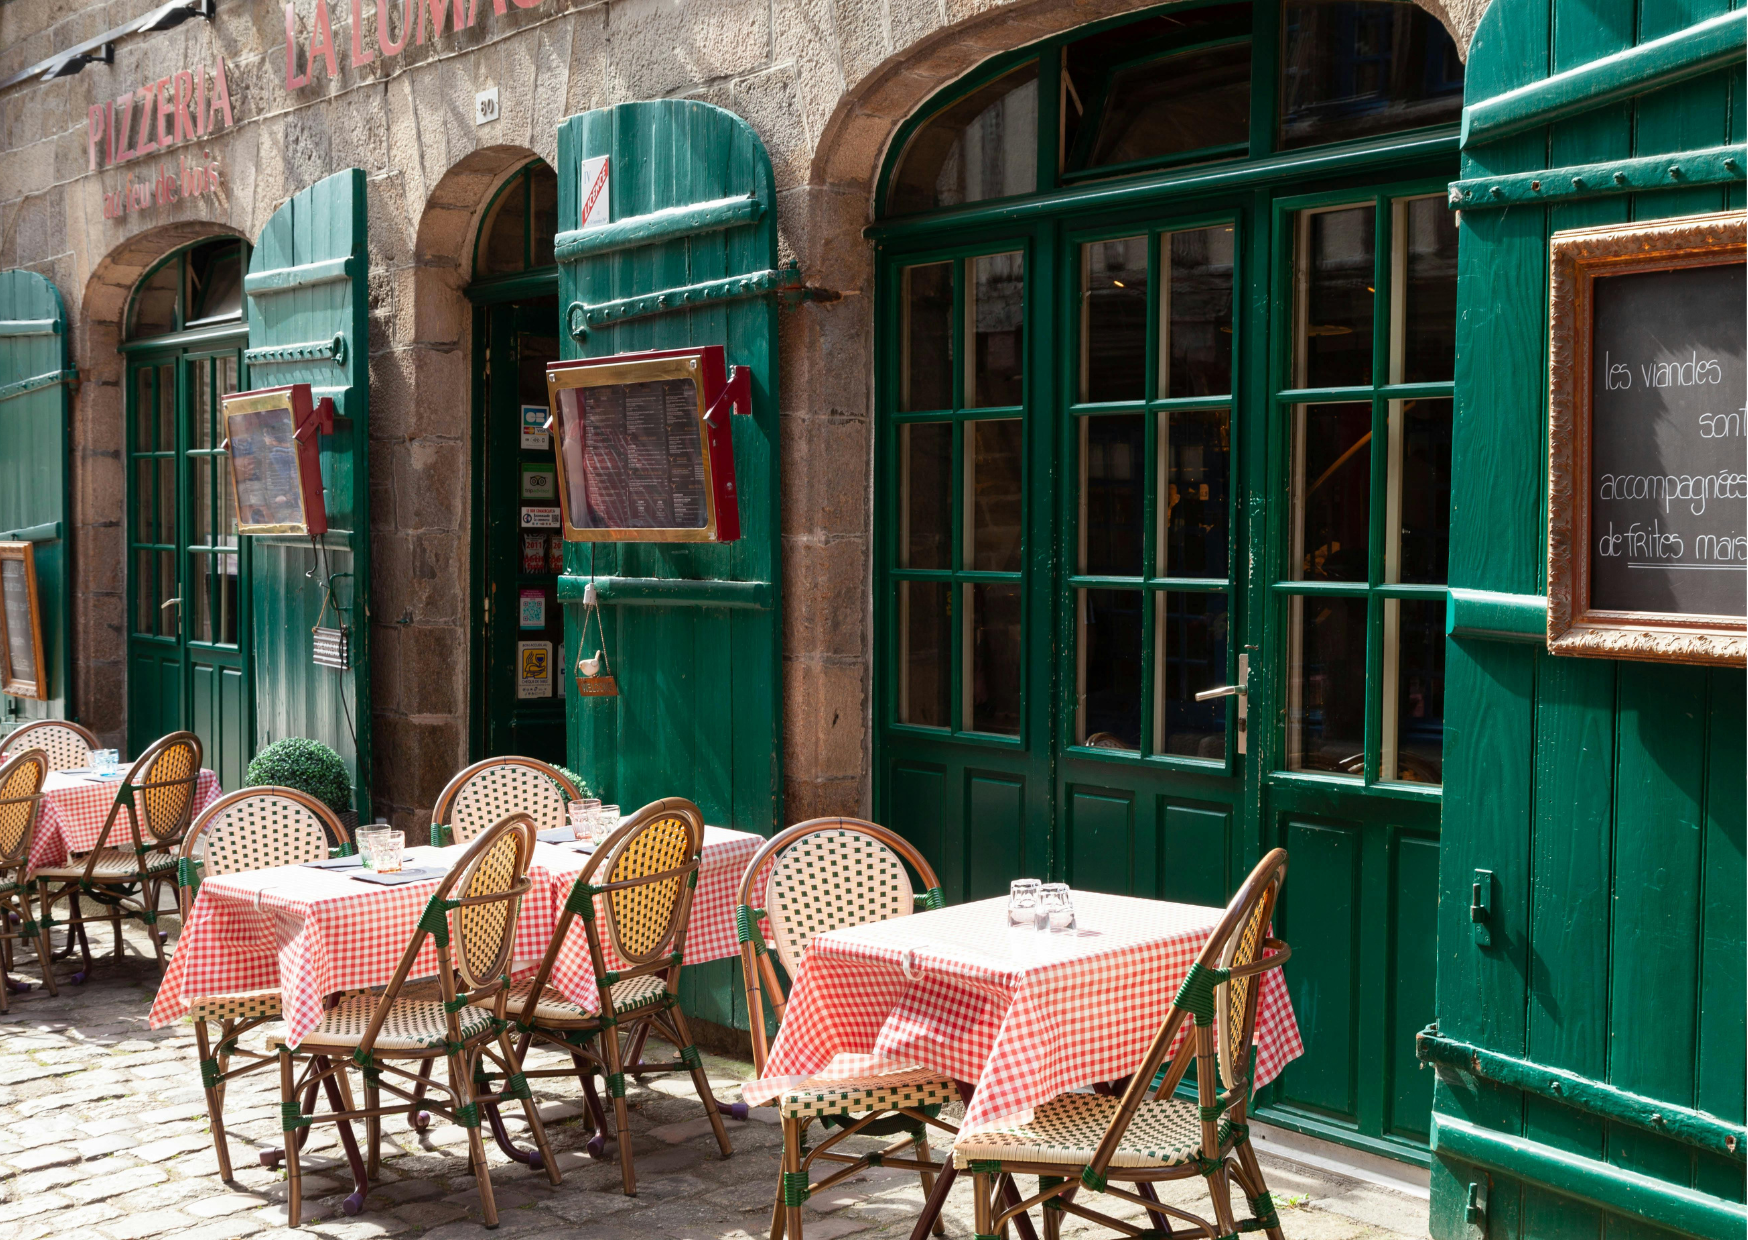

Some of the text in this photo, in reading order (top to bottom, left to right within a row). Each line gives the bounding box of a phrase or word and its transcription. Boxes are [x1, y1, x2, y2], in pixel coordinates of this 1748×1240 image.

[286, 0, 338, 91] LA
[88, 56, 233, 171] PIZZERIA
[103, 149, 220, 219] au feu de bois
[583, 163, 607, 221] LICENCE
[1605, 350, 1722, 390] les viandes
[1698, 400, 1747, 438] sont
[1600, 469, 1747, 516] accompagnées
[526, 541, 542, 549] 2011
[1695, 530, 1747, 560] mais
